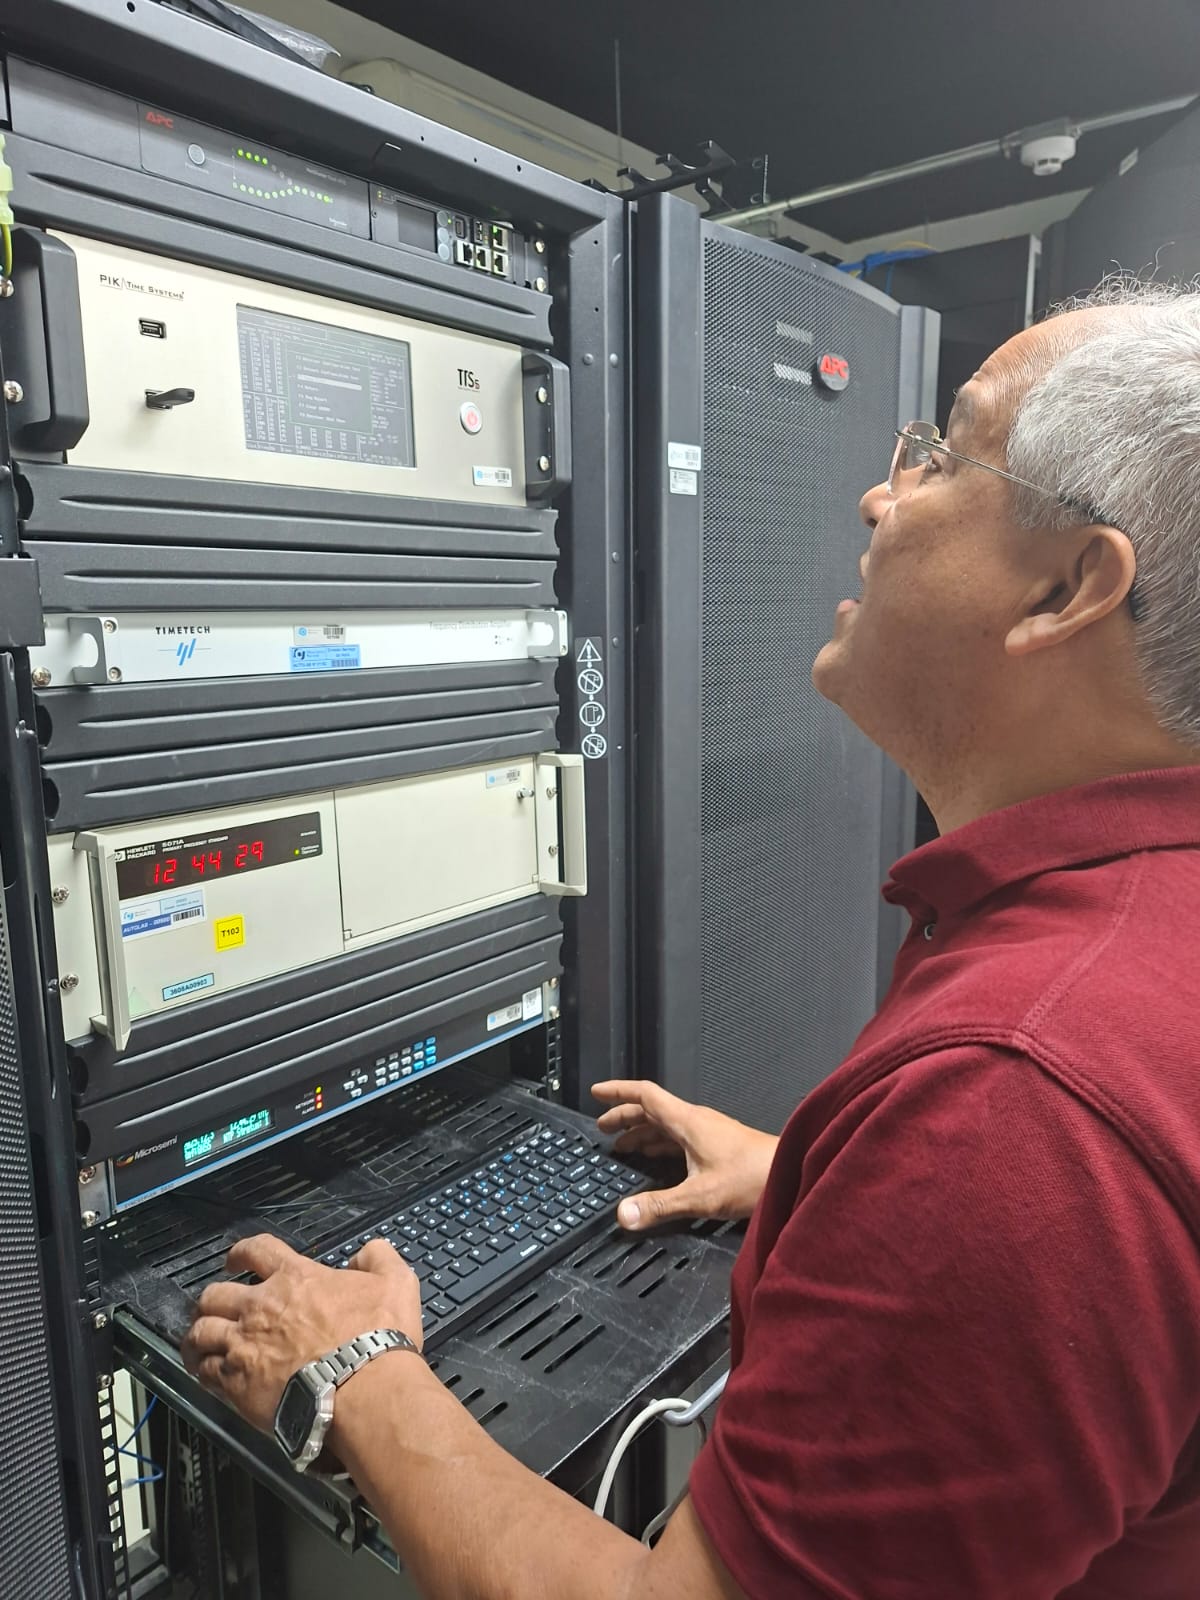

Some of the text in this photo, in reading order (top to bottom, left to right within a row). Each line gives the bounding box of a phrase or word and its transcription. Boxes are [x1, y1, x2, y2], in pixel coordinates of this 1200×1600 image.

[145, 111, 174, 129] APC
[99, 274, 120, 287] PIK
[820, 354, 849, 379] APC
[155, 625, 211, 635] TIMETECH
[126, 844, 155, 854] HEWLETT
[162, 839, 184, 849] 5071A
[127, 850, 156, 860] PACKARD
[153, 841, 264, 885] 12 44 29
[221, 926, 240, 938] T103
[134, 1135, 178, 1160] Microsemi
